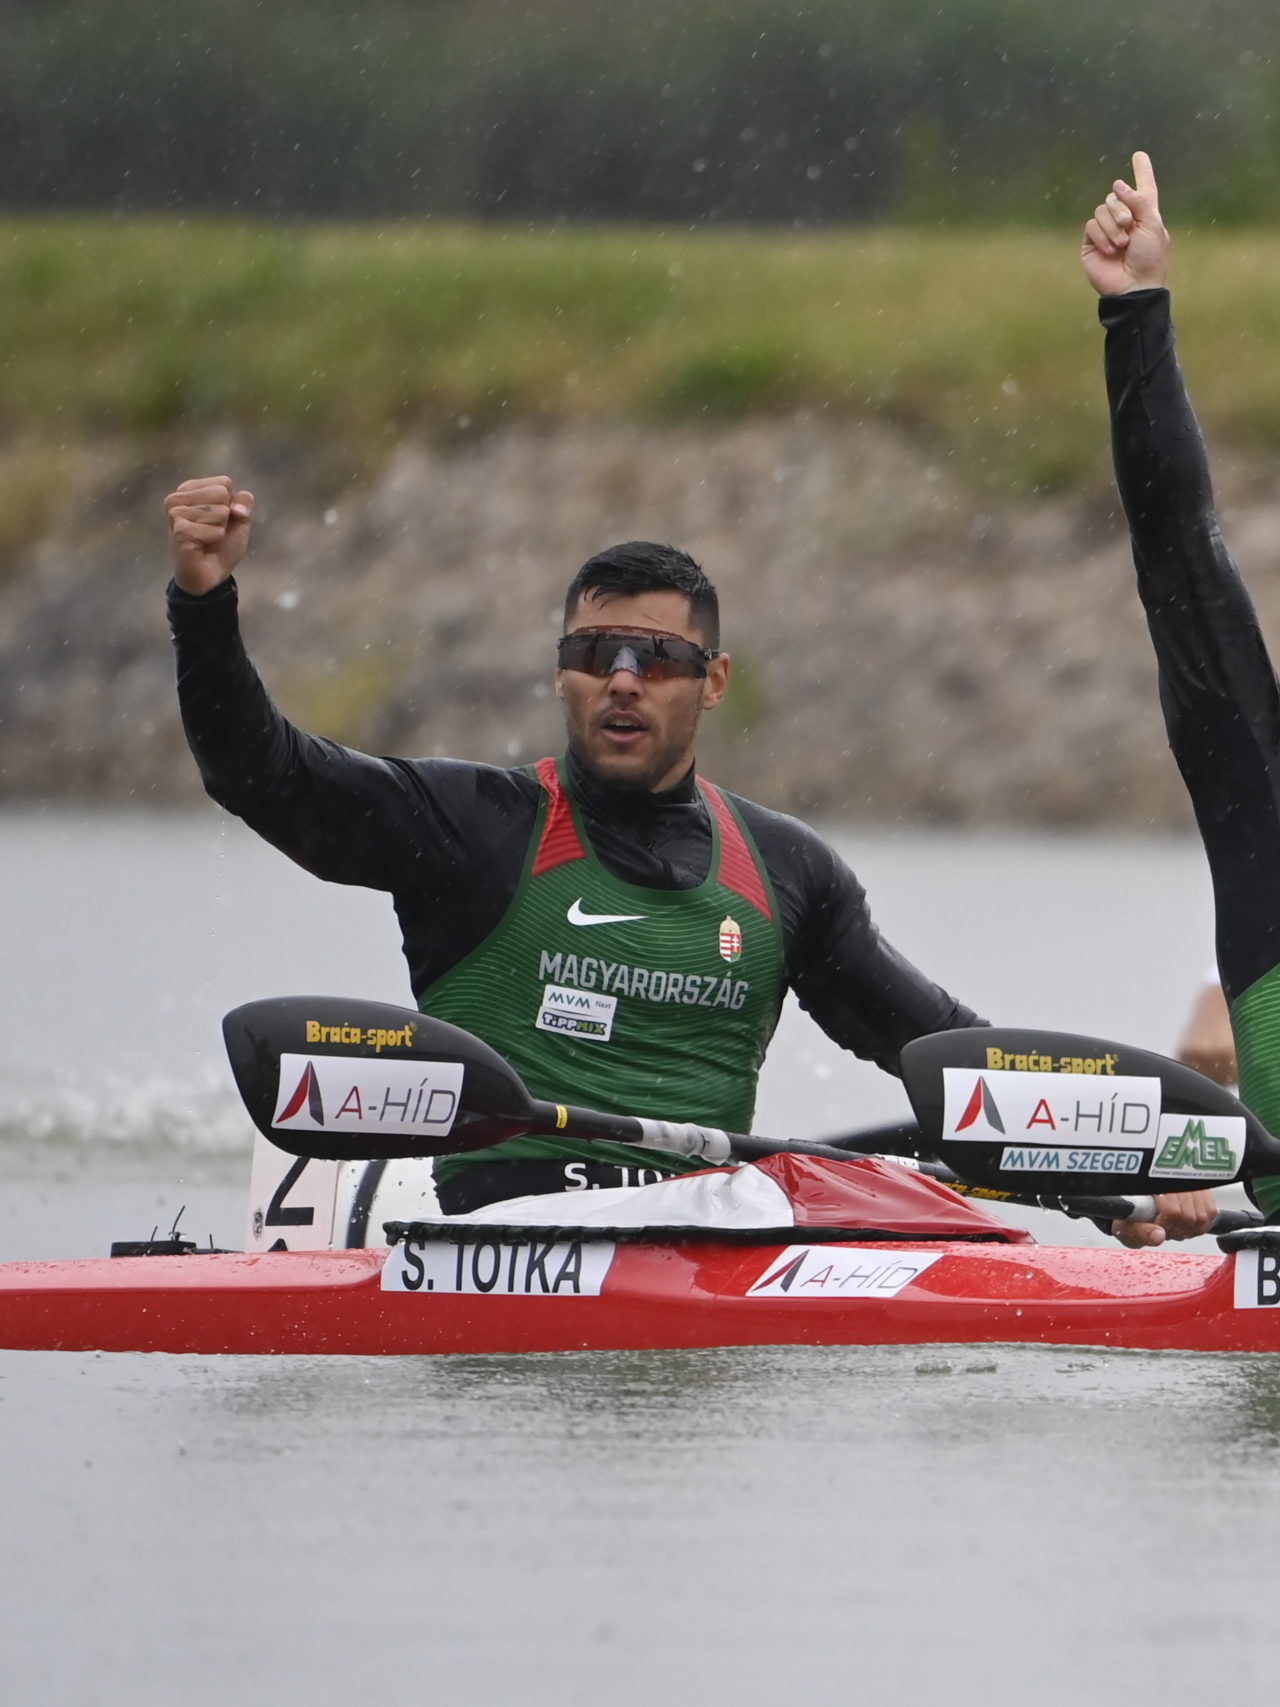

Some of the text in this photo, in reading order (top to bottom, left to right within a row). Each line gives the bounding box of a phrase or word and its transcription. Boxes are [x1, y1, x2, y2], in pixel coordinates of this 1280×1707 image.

[538, 950, 749, 1010] MAGYARORSZÁG
[548, 991, 612, 1010] MVM Next
[335, 1077, 456, 1125] A-HÍD
[1026, 1092, 1151, 1134] A-HÍD
[1002, 1150, 1140, 1172] MVM SZEGED
[401, 1239, 582, 1293] S. TOTKA
[800, 1260, 919, 1289] A-HÍD
